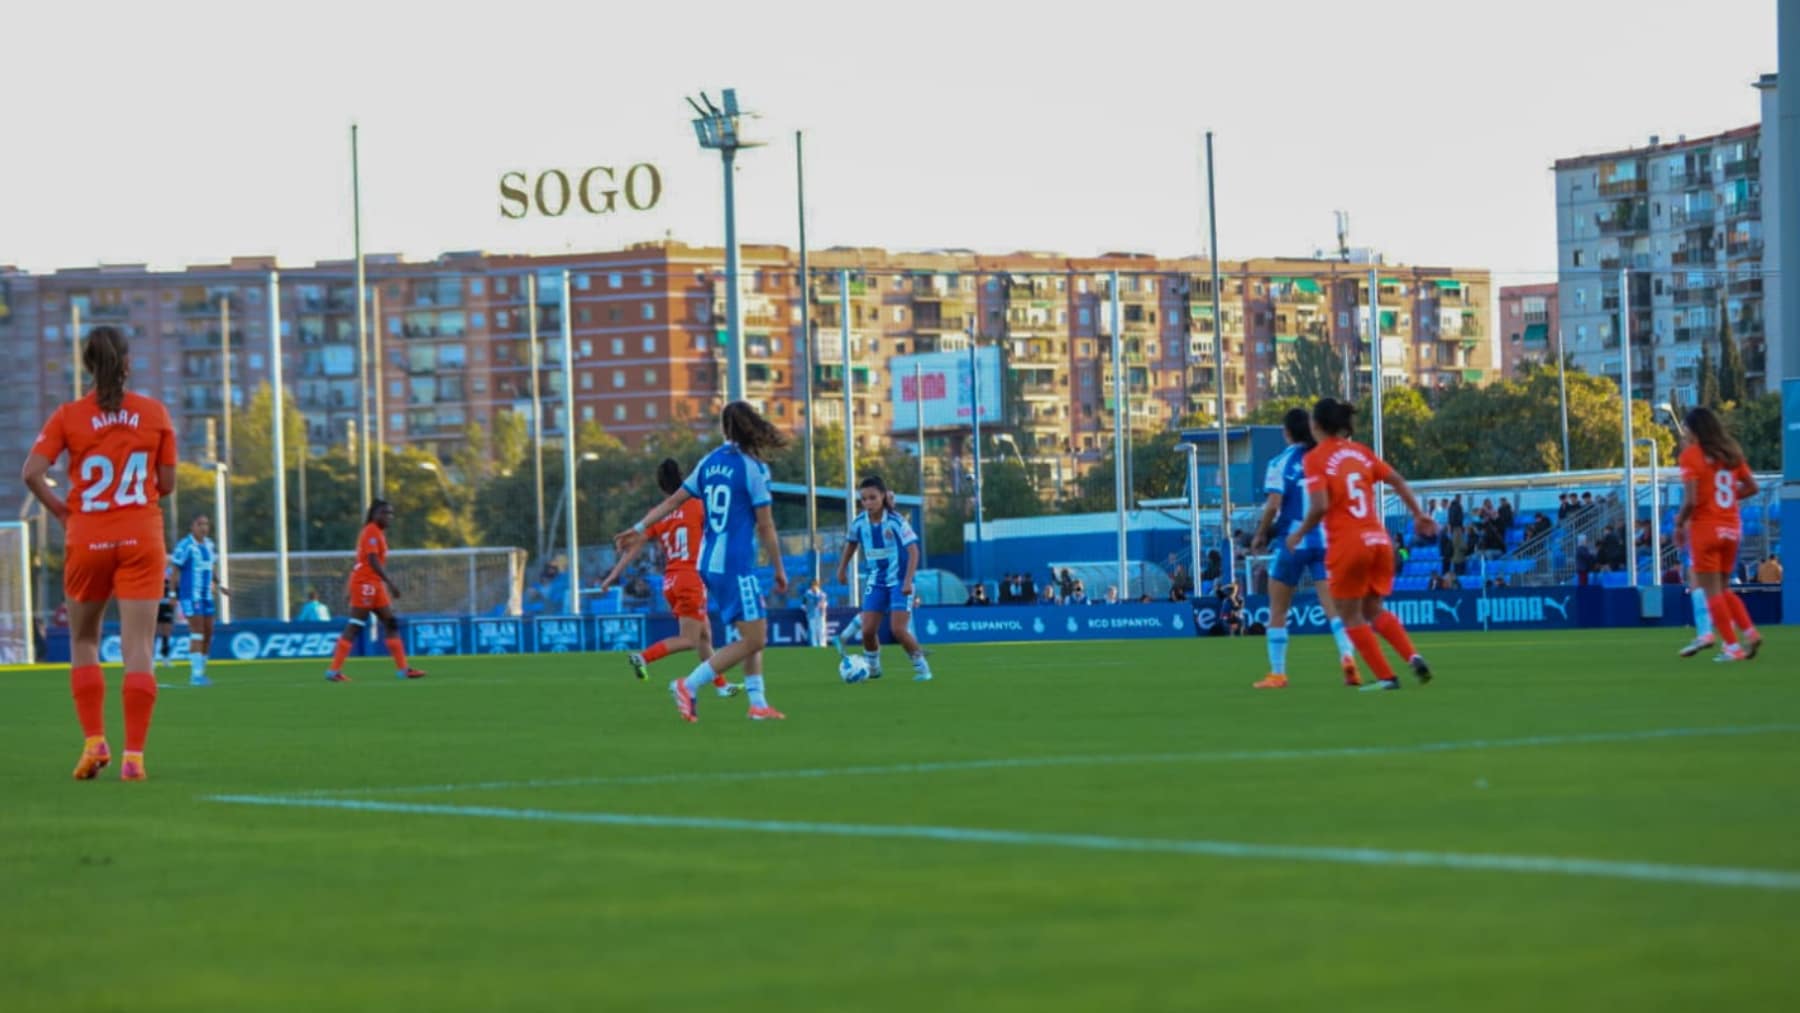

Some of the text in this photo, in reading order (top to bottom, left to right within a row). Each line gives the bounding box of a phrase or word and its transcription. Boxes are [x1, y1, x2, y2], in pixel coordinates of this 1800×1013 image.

[499, 162, 662, 219] SOGO
[91, 410, 140, 430] AIARA
[81, 452, 148, 513] 24
[1346, 472, 1367, 518] 5
[1715, 469, 1734, 508] 8
[704, 484, 732, 534] 19
[1382, 600, 1434, 624] UMA
[1476, 597, 1543, 622] PUMA
